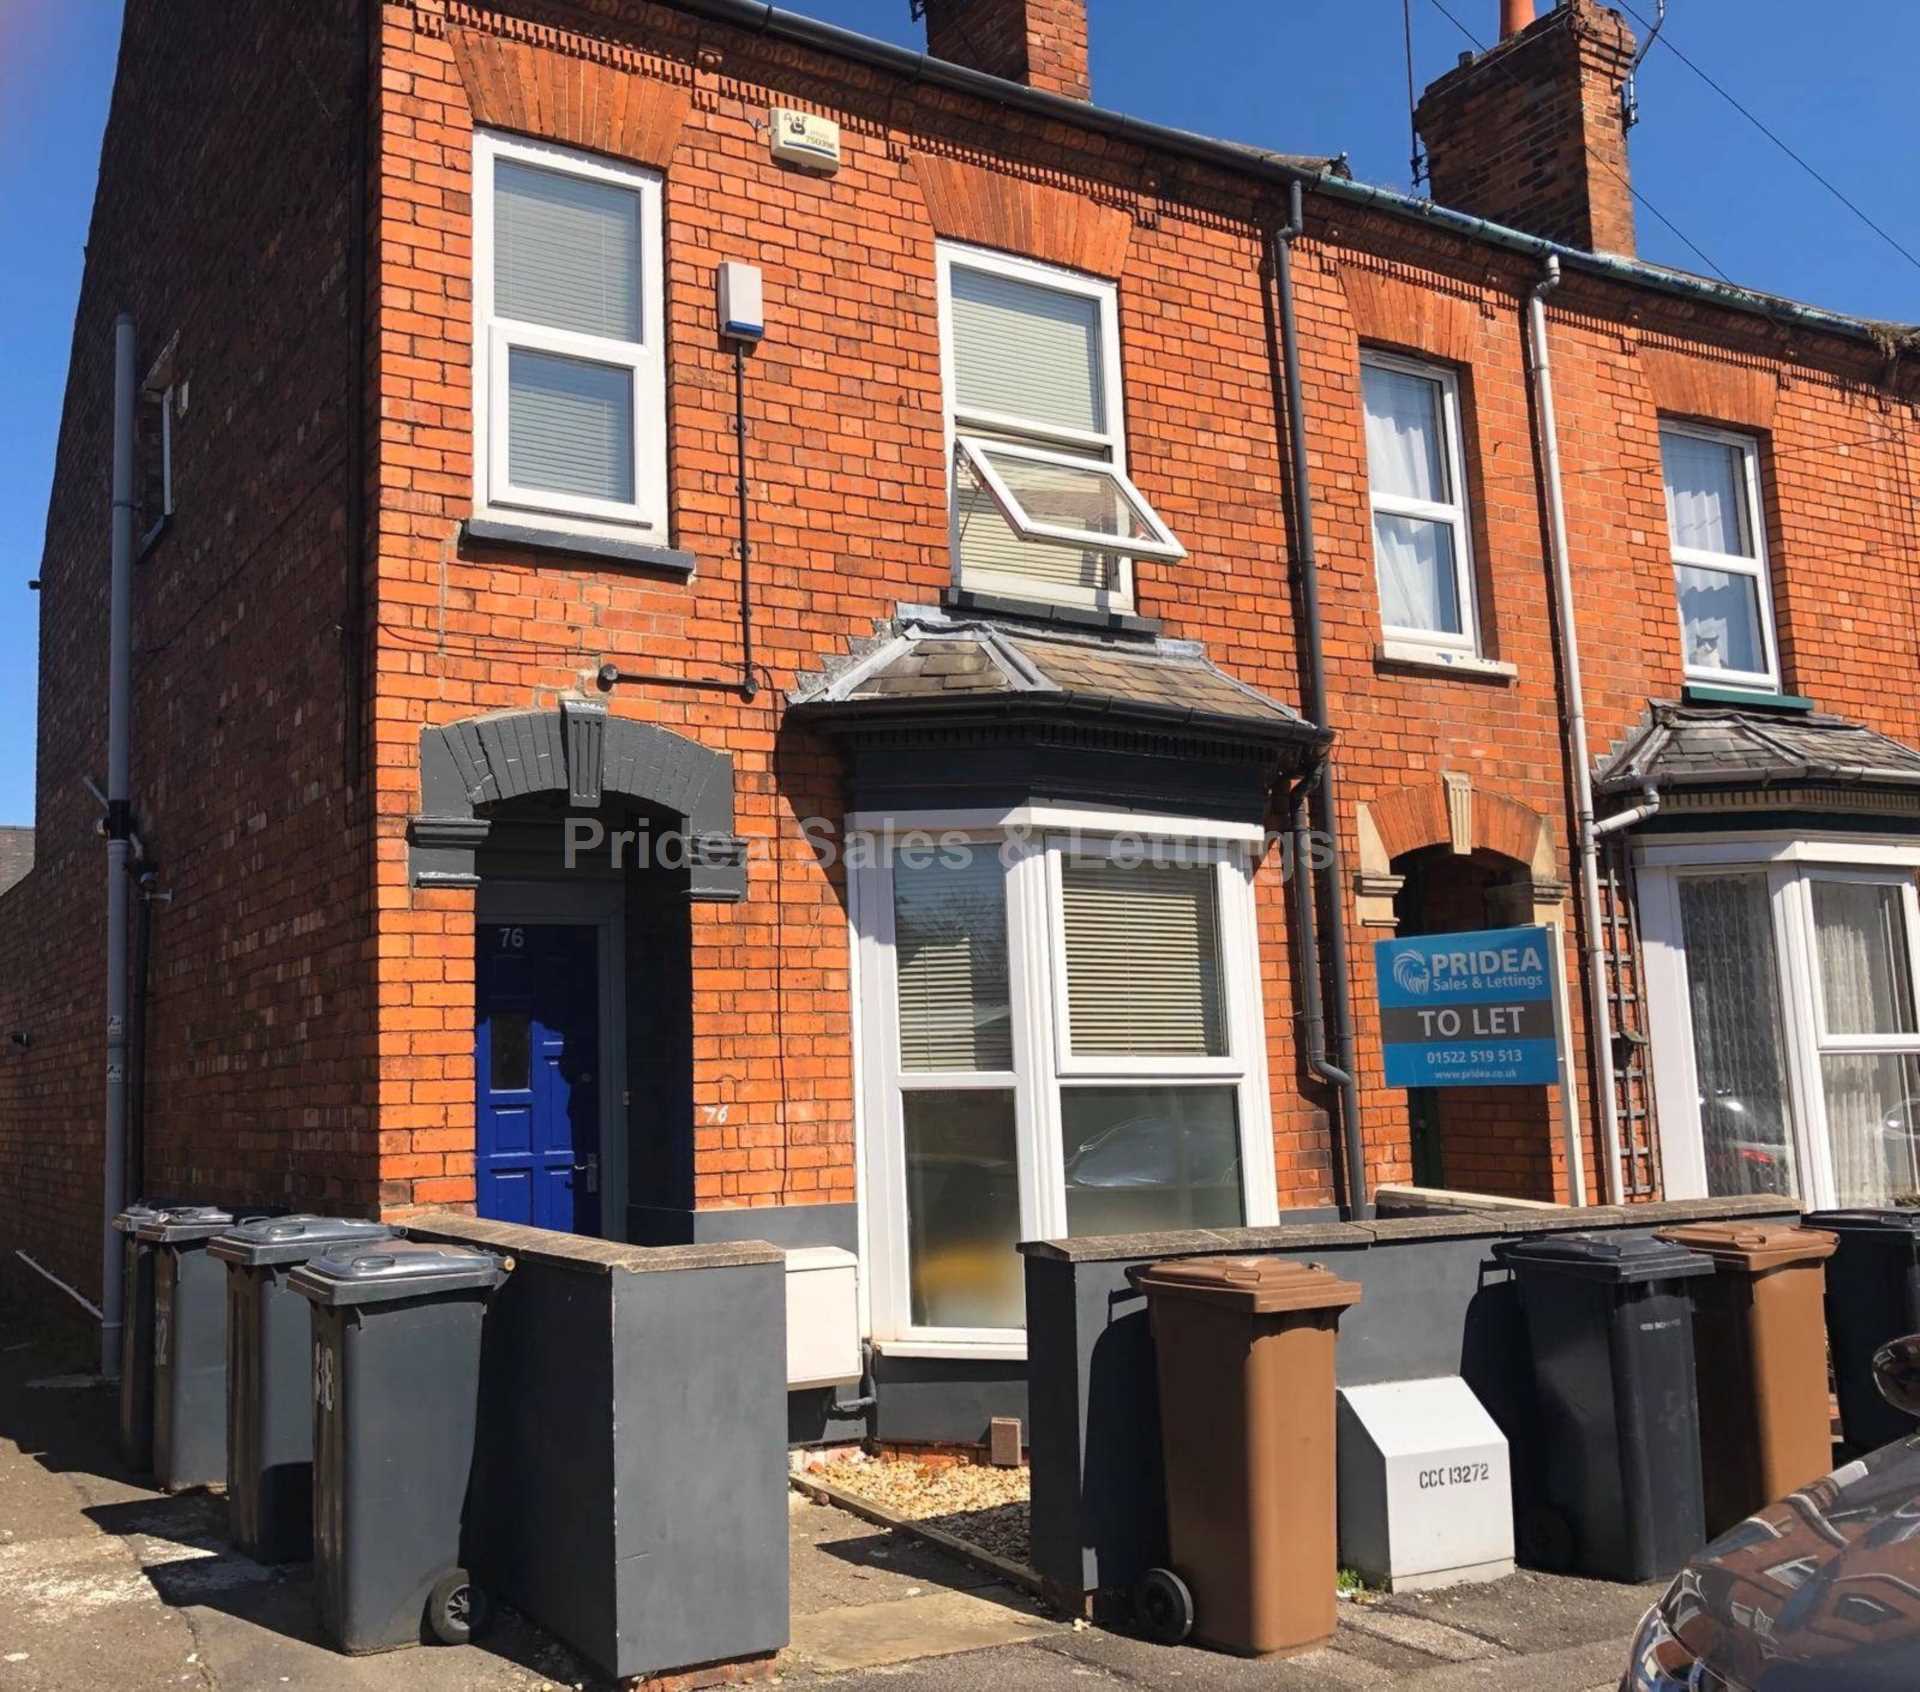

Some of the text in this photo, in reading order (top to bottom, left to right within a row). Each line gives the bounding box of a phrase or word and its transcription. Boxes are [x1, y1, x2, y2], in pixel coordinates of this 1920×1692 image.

[499, 928, 524, 948] 76
[1432, 948, 1543, 977] PRIDEA
[1433, 974, 1543, 992] Sales & Lettings
[1417, 1006, 1525, 1037] TO LET
[1426, 1049, 1523, 1065] 01522 519 513
[702, 1104, 729, 1125] 76
[1449, 1463, 1489, 1485] 13272
